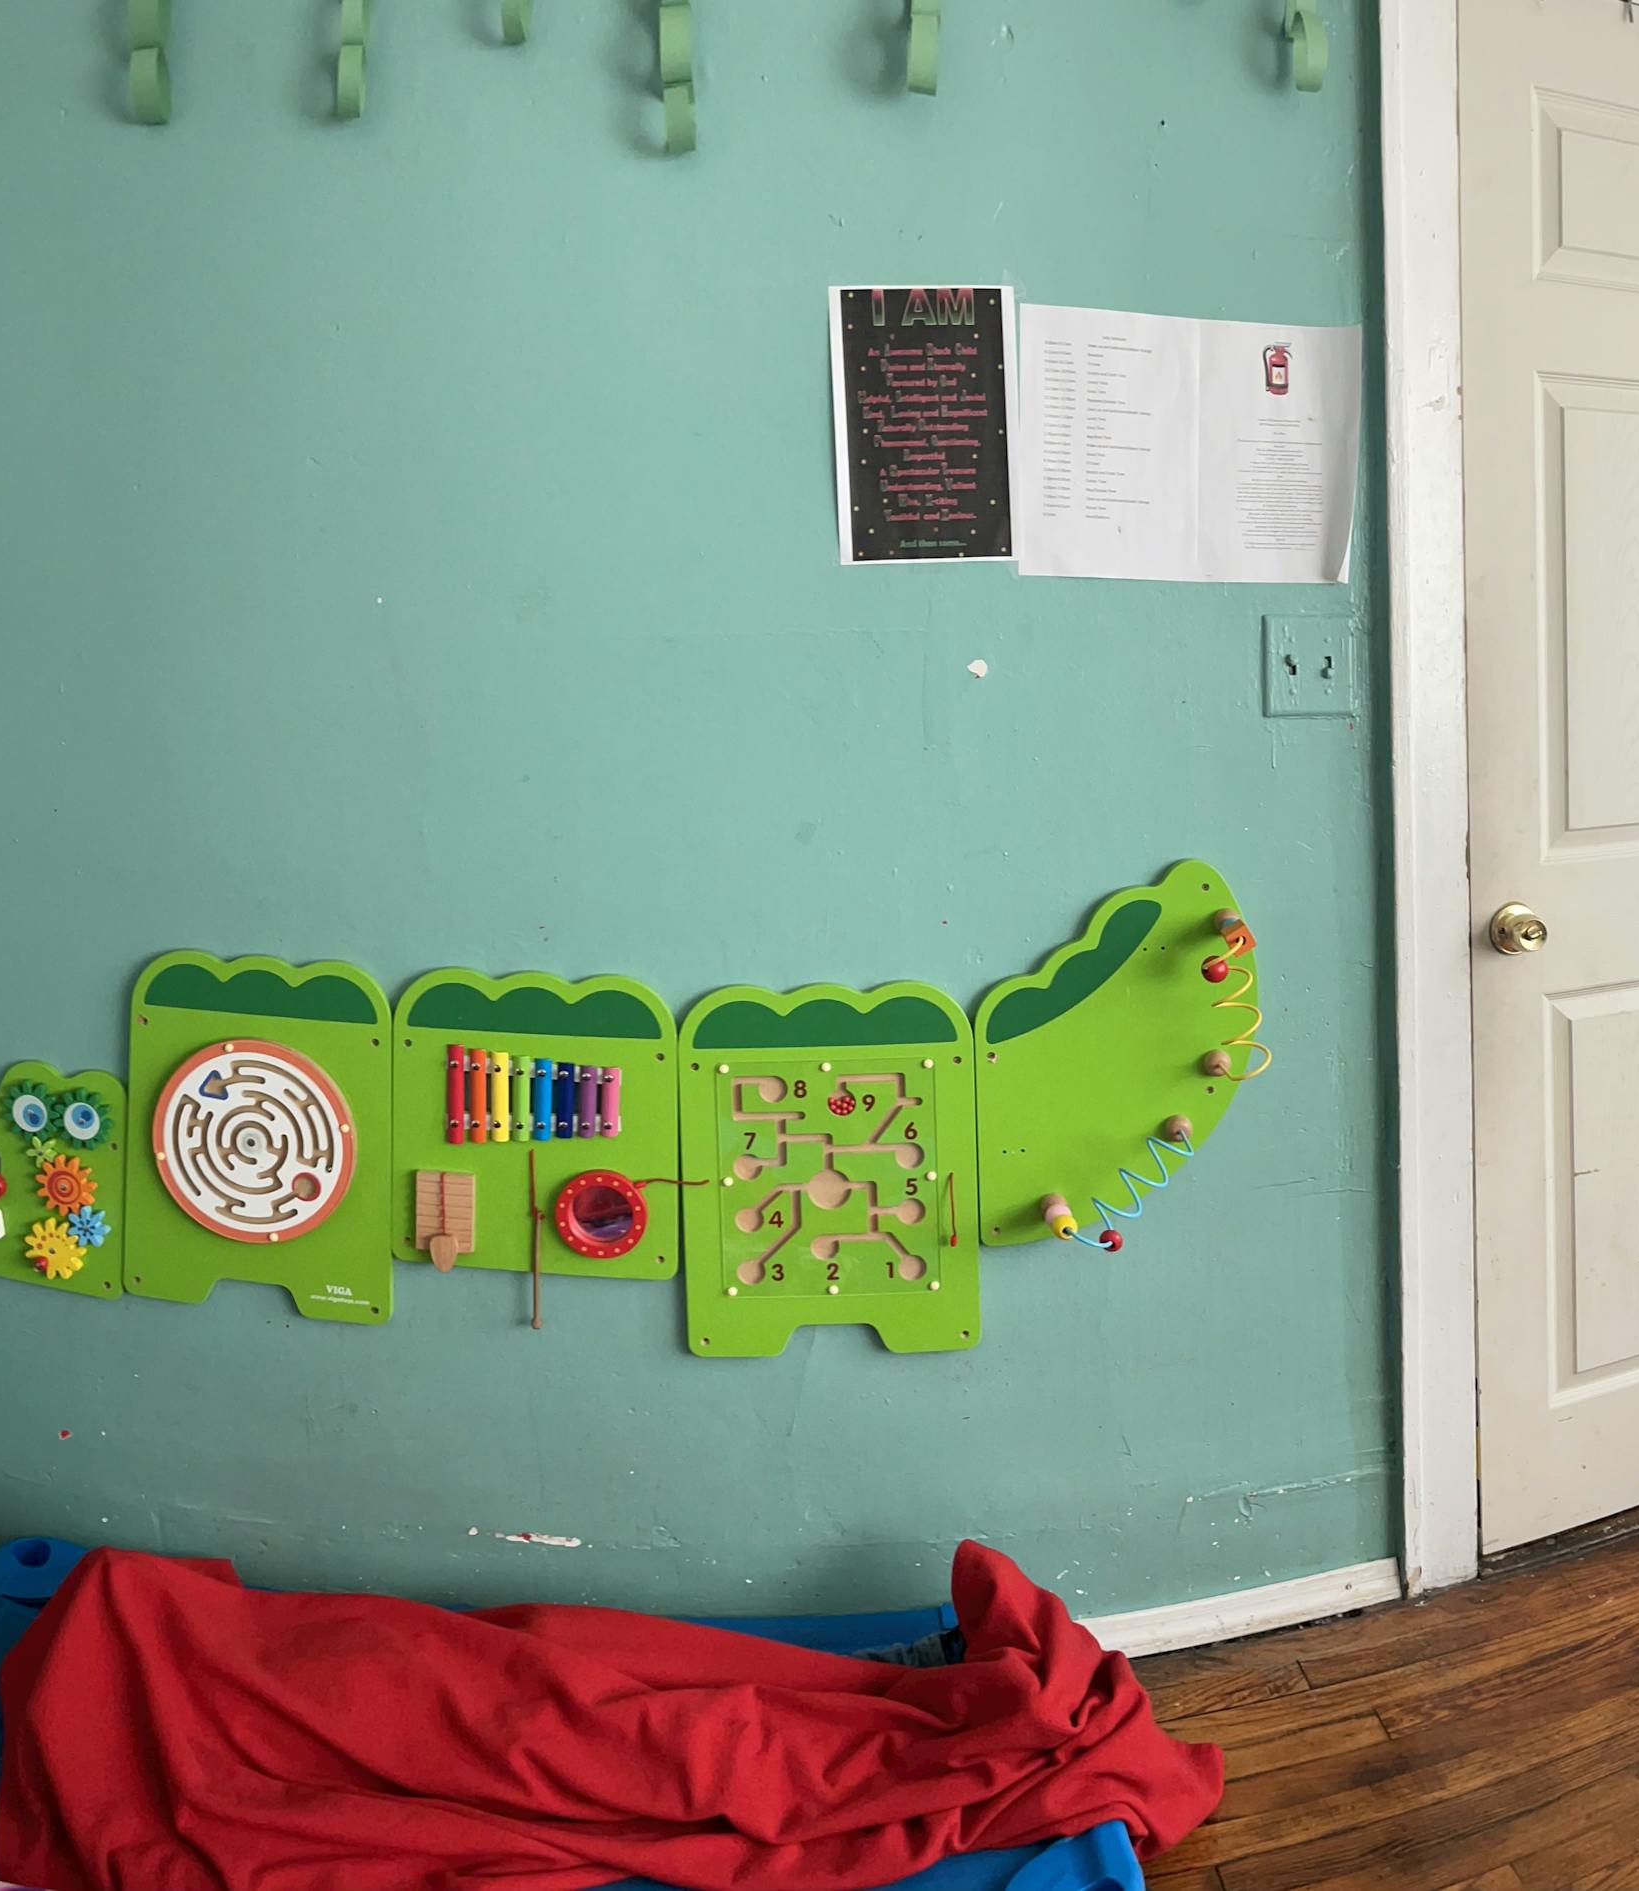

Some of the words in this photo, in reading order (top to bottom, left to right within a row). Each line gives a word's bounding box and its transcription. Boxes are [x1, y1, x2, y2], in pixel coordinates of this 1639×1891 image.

[871, 289, 885, 326] I
[901, 289, 975, 326] AM
[794, 1080, 806, 1098] 8
[862, 1094, 875, 1111] 9
[905, 1122, 917, 1140] 6
[744, 1132, 756, 1149] 7
[906, 1178, 917, 1195] 5
[769, 1211, 783, 1227] 4
[772, 1264, 784, 1281] 3
[827, 1263, 839, 1280] 2
[886, 1262, 894, 1278] 1
[326, 1284, 352, 1296] VIGA
